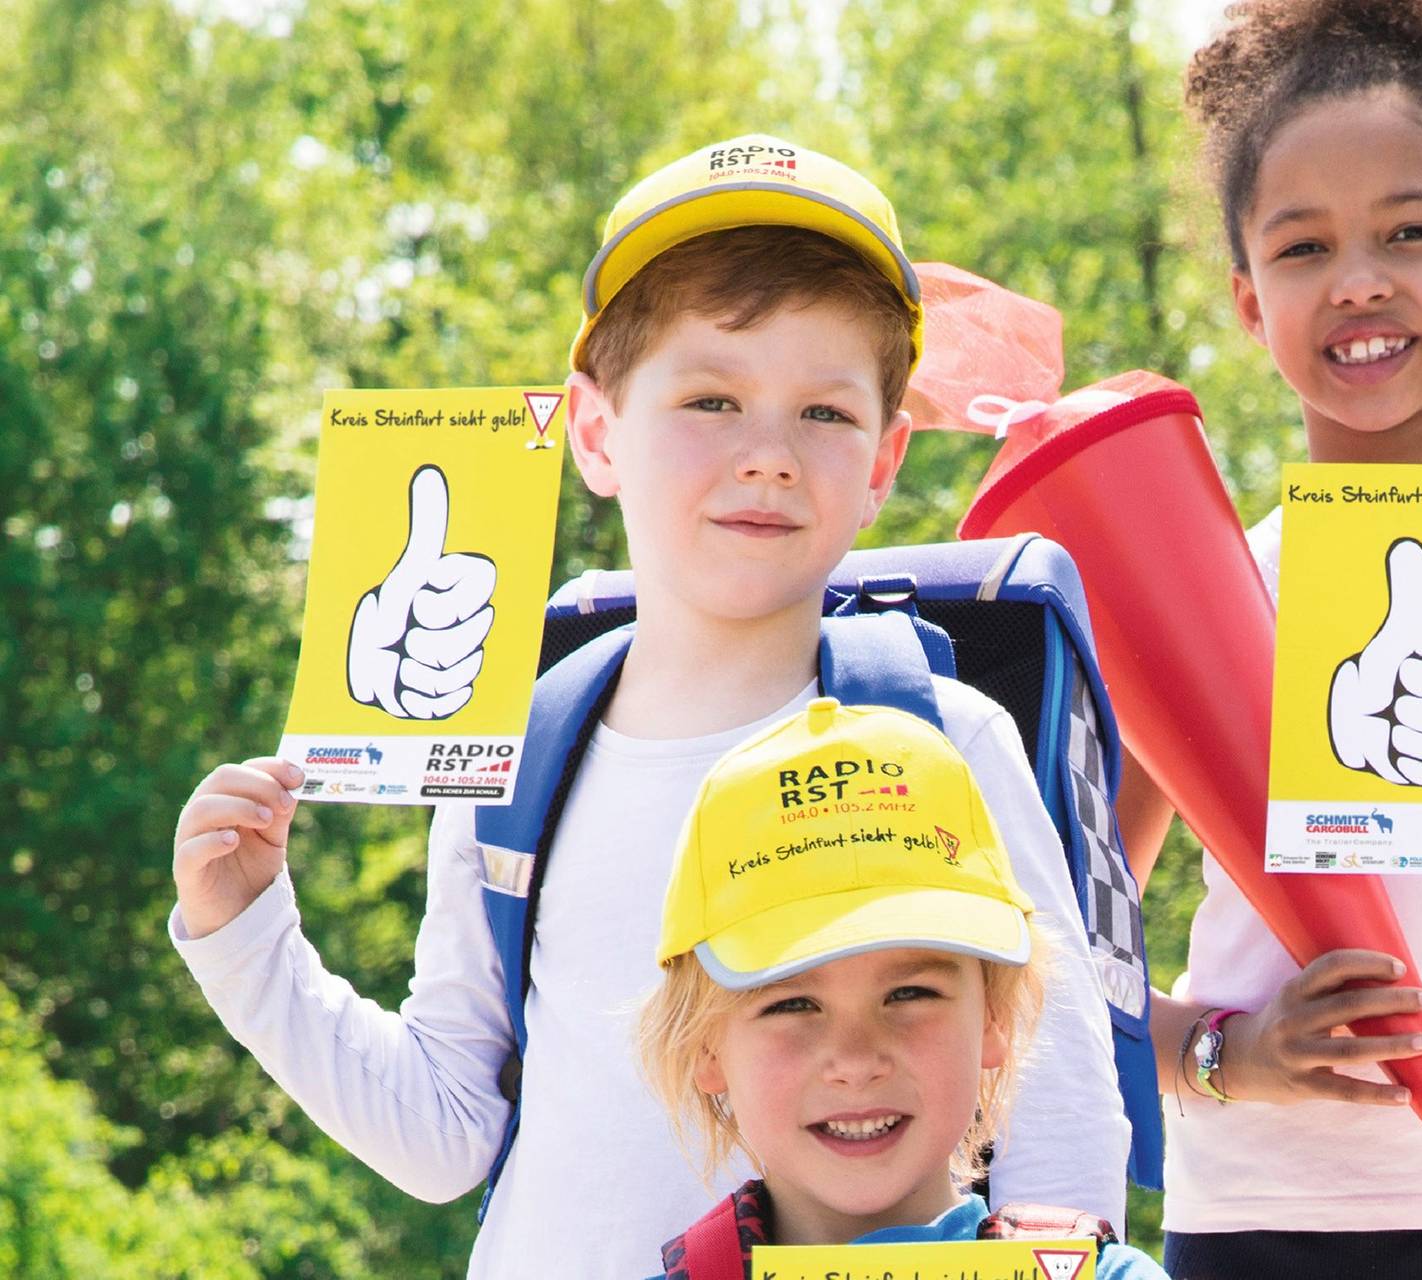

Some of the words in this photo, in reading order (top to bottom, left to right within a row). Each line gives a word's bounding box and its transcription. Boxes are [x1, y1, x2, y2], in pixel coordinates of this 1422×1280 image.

[711, 146, 795, 158] RADIO
[710, 154, 755, 170] RST
[709, 170, 734, 181] 104.0
[331, 408, 368, 426] Kreis
[375, 409, 443, 427] Steinfurt
[449, 408, 486, 426] sieht
[492, 407, 526, 432] gelb!
[1289, 485, 1333, 503] Kreis
[307, 748, 363, 757] SCHMITZ
[430, 744, 514, 757] RADIO
[426, 759, 472, 771] RST
[779, 759, 904, 787] RADIO
[423, 776, 448, 784] 104.0
[457, 776, 482, 785] 105.2
[484, 777, 507, 785] MHz
[781, 781, 849, 808] RST
[781, 806, 818, 824] 104.0
[834, 803, 874, 813] 105.2
[1306, 815, 1368, 825] SCHMITZ
[1306, 825, 1368, 833] CARGOBULL
[729, 852, 770, 879] Kreis
[776, 833, 847, 861] Steinfurt
[850, 828, 896, 843] sieht
[903, 833, 941, 855] gelb!
